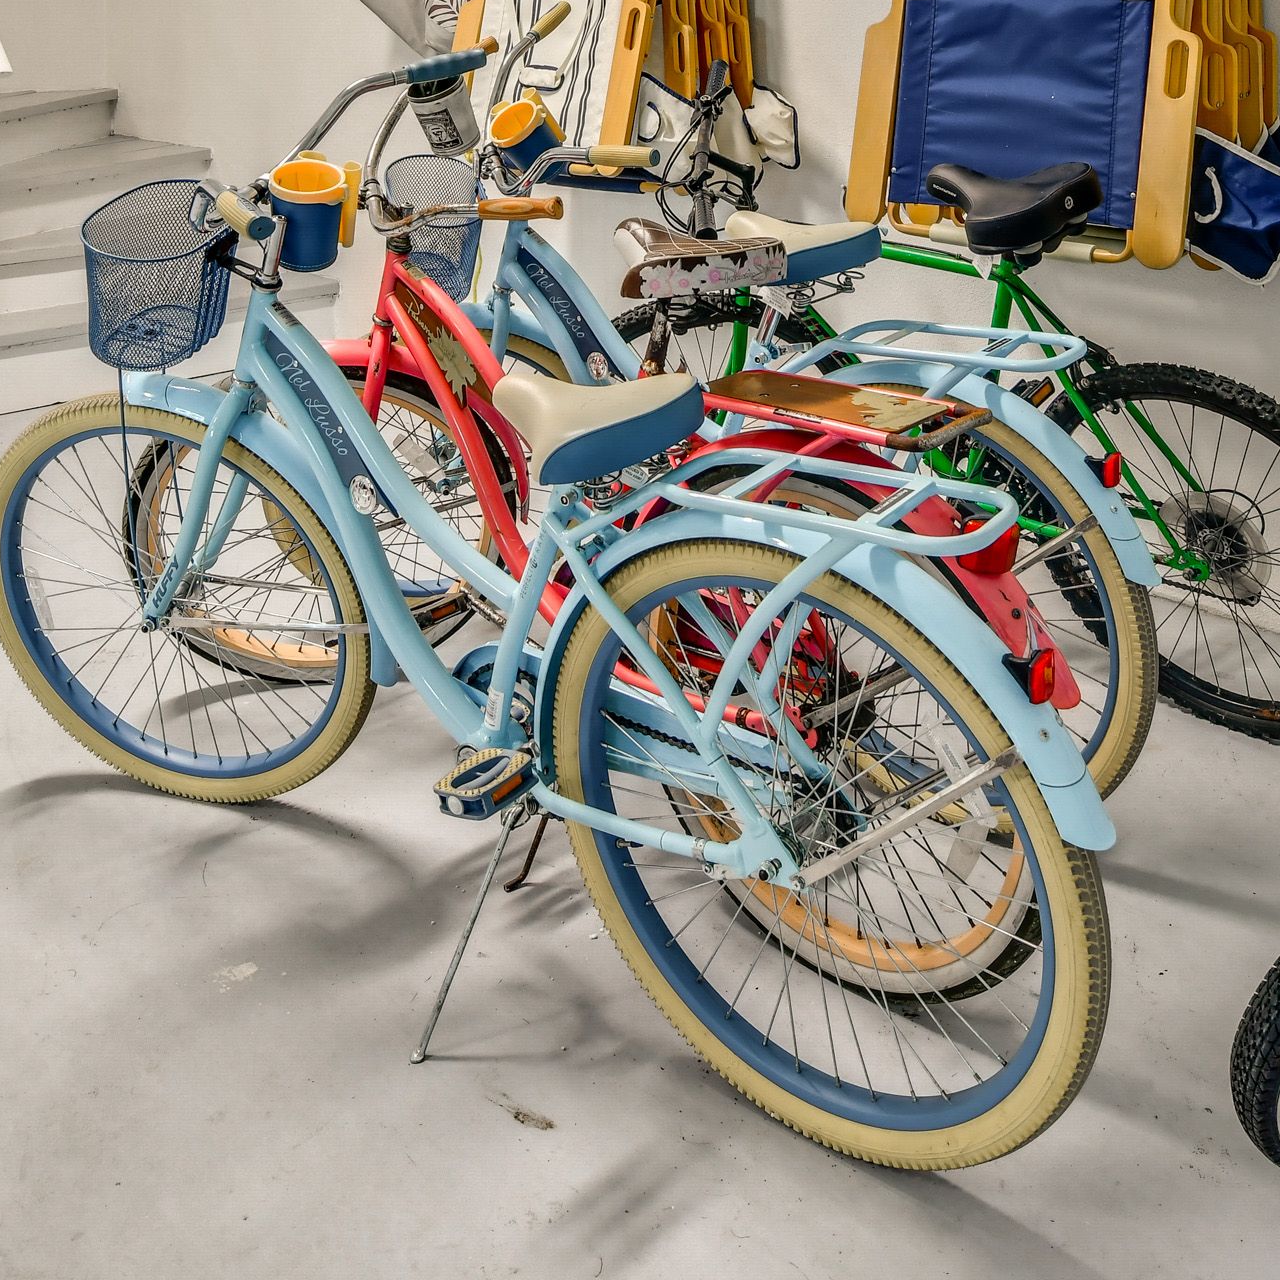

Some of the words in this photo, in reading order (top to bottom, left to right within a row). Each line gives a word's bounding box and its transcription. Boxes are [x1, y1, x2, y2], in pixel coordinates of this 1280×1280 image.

[549, 295, 585, 338] Lusso
[275, 352, 311, 392] Nel
[305, 397, 348, 456] Lusso
[152, 554, 179, 609] HUFFY
